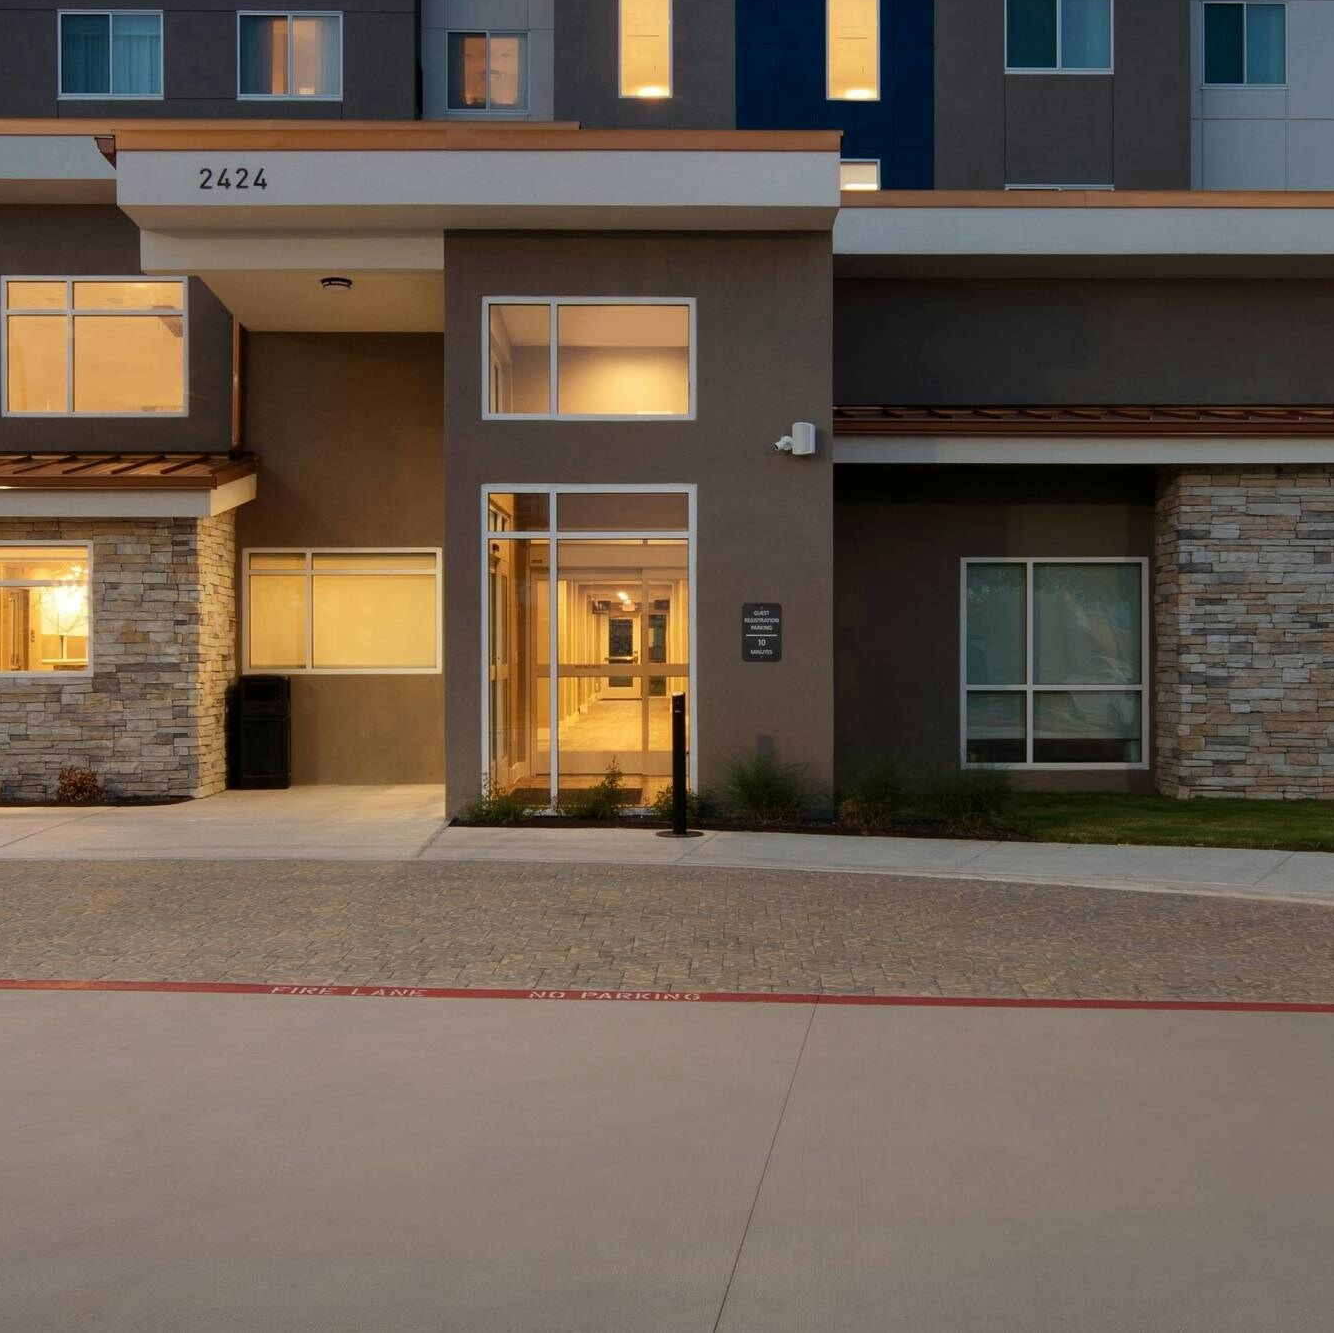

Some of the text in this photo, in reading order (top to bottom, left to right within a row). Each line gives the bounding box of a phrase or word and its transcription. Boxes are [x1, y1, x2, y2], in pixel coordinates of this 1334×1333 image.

[199, 167, 268, 190] 2424
[758, 638, 766, 647] 10
[270, 986, 701, 1001] FIRE LANE NO PARKING
